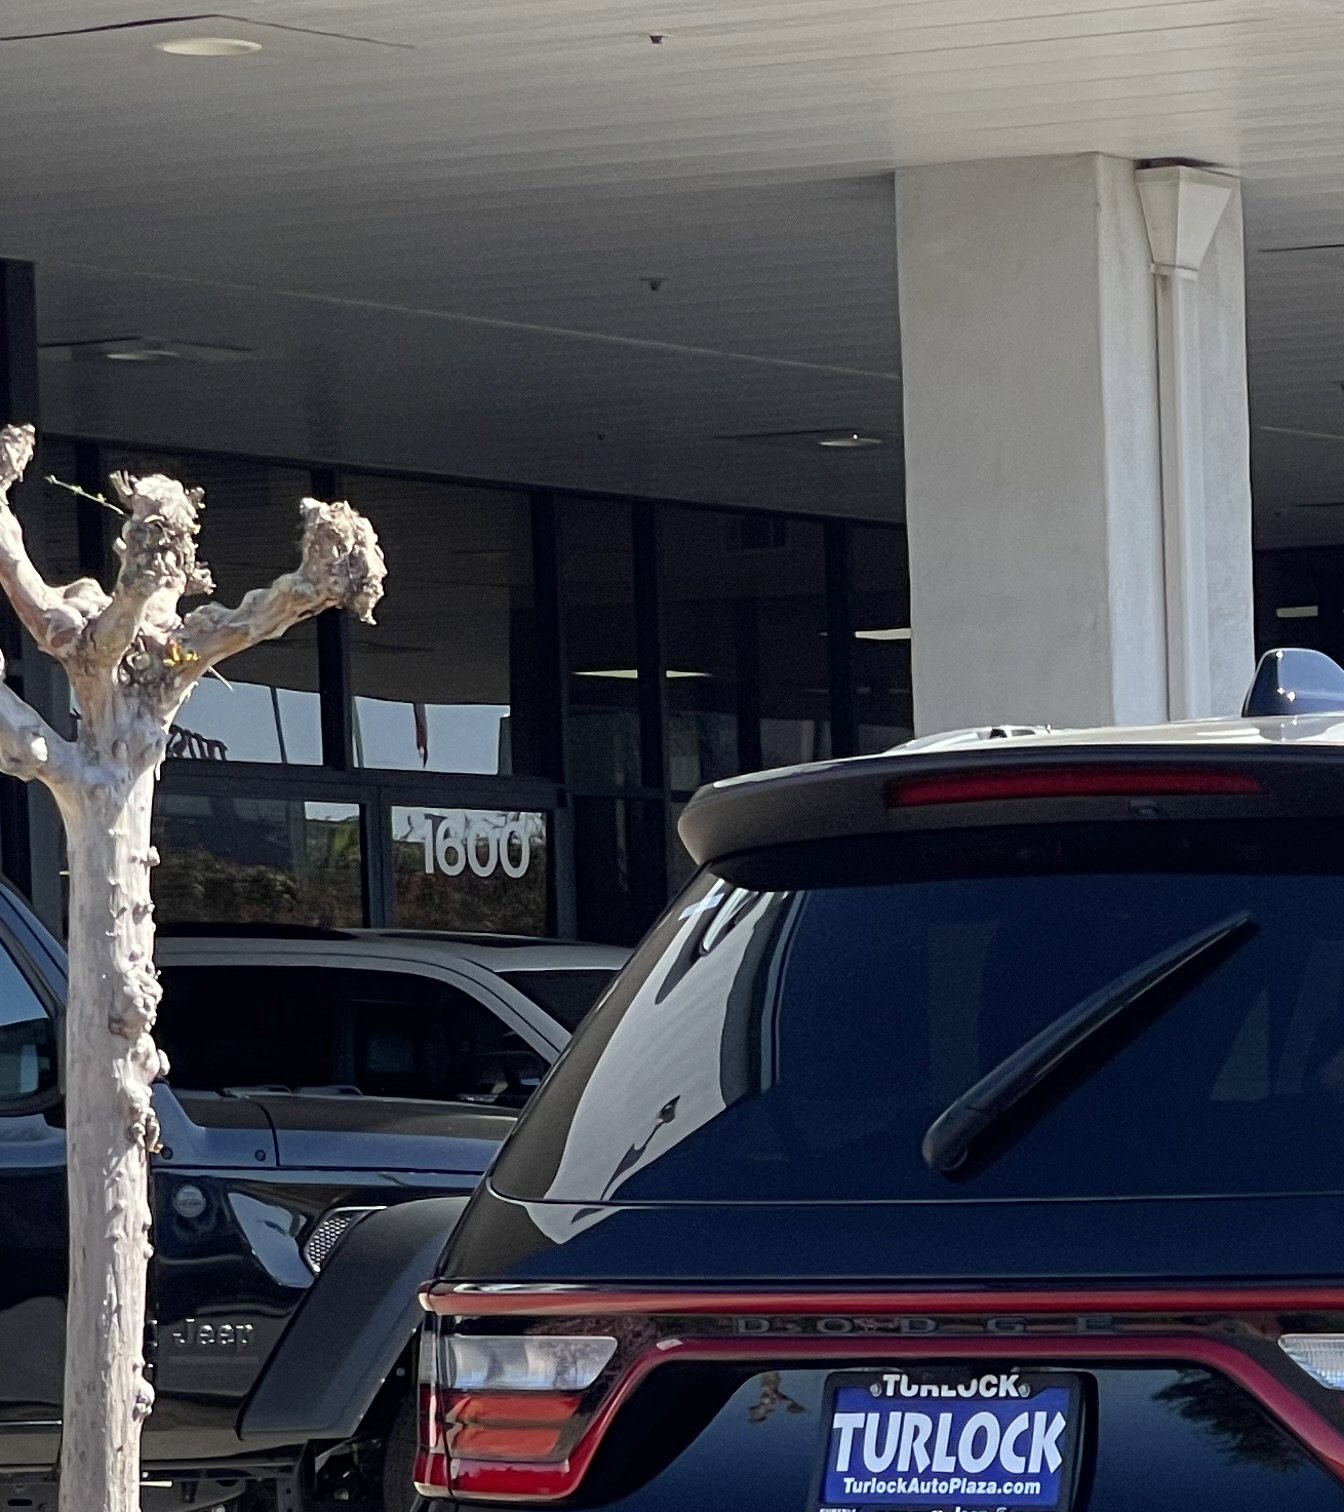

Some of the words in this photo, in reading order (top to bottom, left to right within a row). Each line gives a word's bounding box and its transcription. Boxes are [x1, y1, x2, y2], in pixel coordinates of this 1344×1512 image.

[424, 818, 531, 879] 1600
[172, 1318, 256, 1351] Jeep
[737, 1316, 1115, 1335] DODGE
[832, 1410, 1067, 1475] TURLOCK
[843, 1477, 1041, 1496] TurlockAutoPlaza.com
